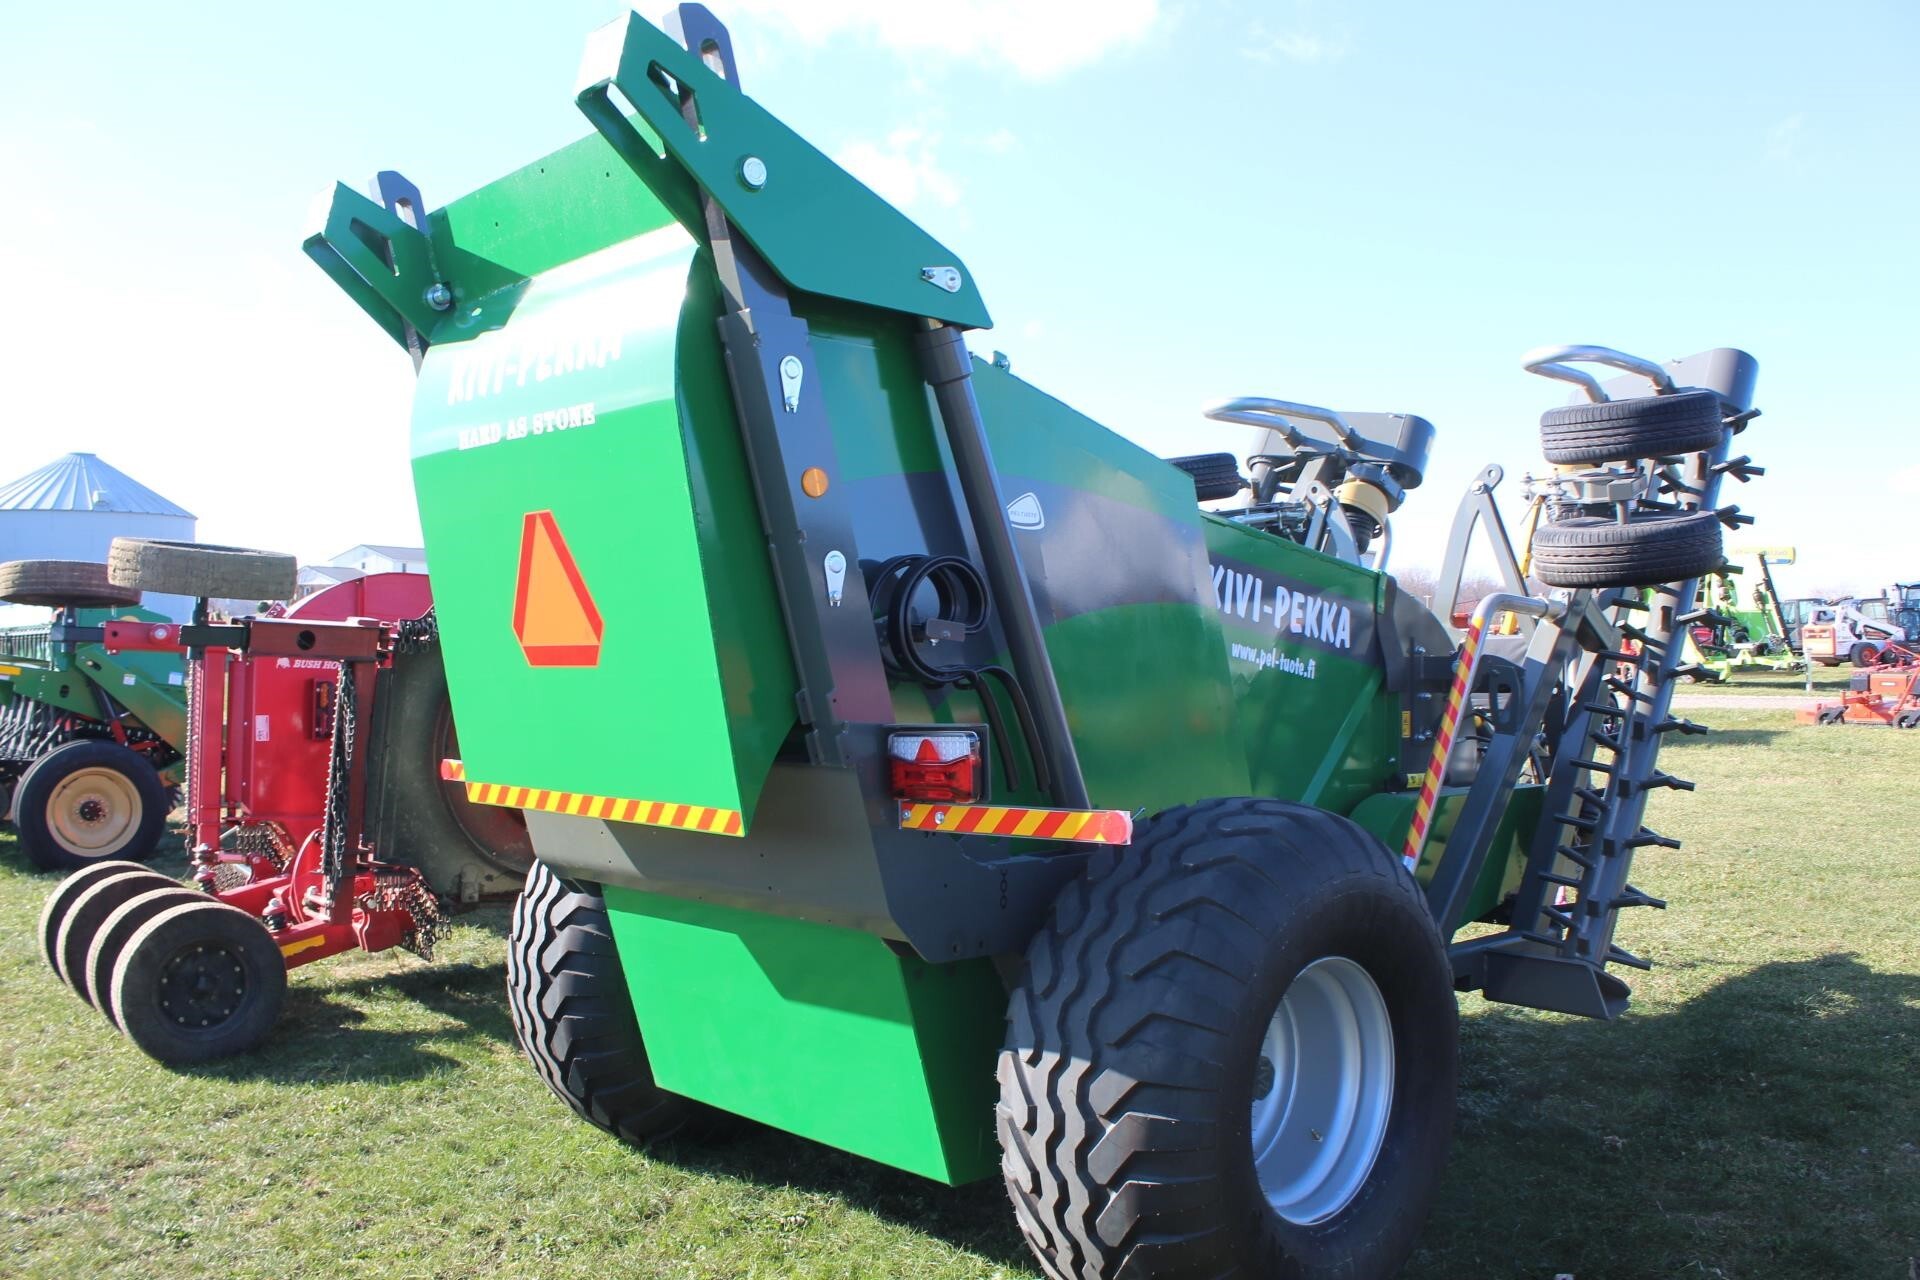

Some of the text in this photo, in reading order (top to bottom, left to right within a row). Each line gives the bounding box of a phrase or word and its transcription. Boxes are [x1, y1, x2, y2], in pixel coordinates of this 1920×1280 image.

[457, 402, 596, 451] HARD AS STONE
[1209, 564, 1351, 649] KIVI-PEKKA
[293, 659, 321, 668] BUSH
[1231, 642, 1316, 679] www.pel-tuote.fi
